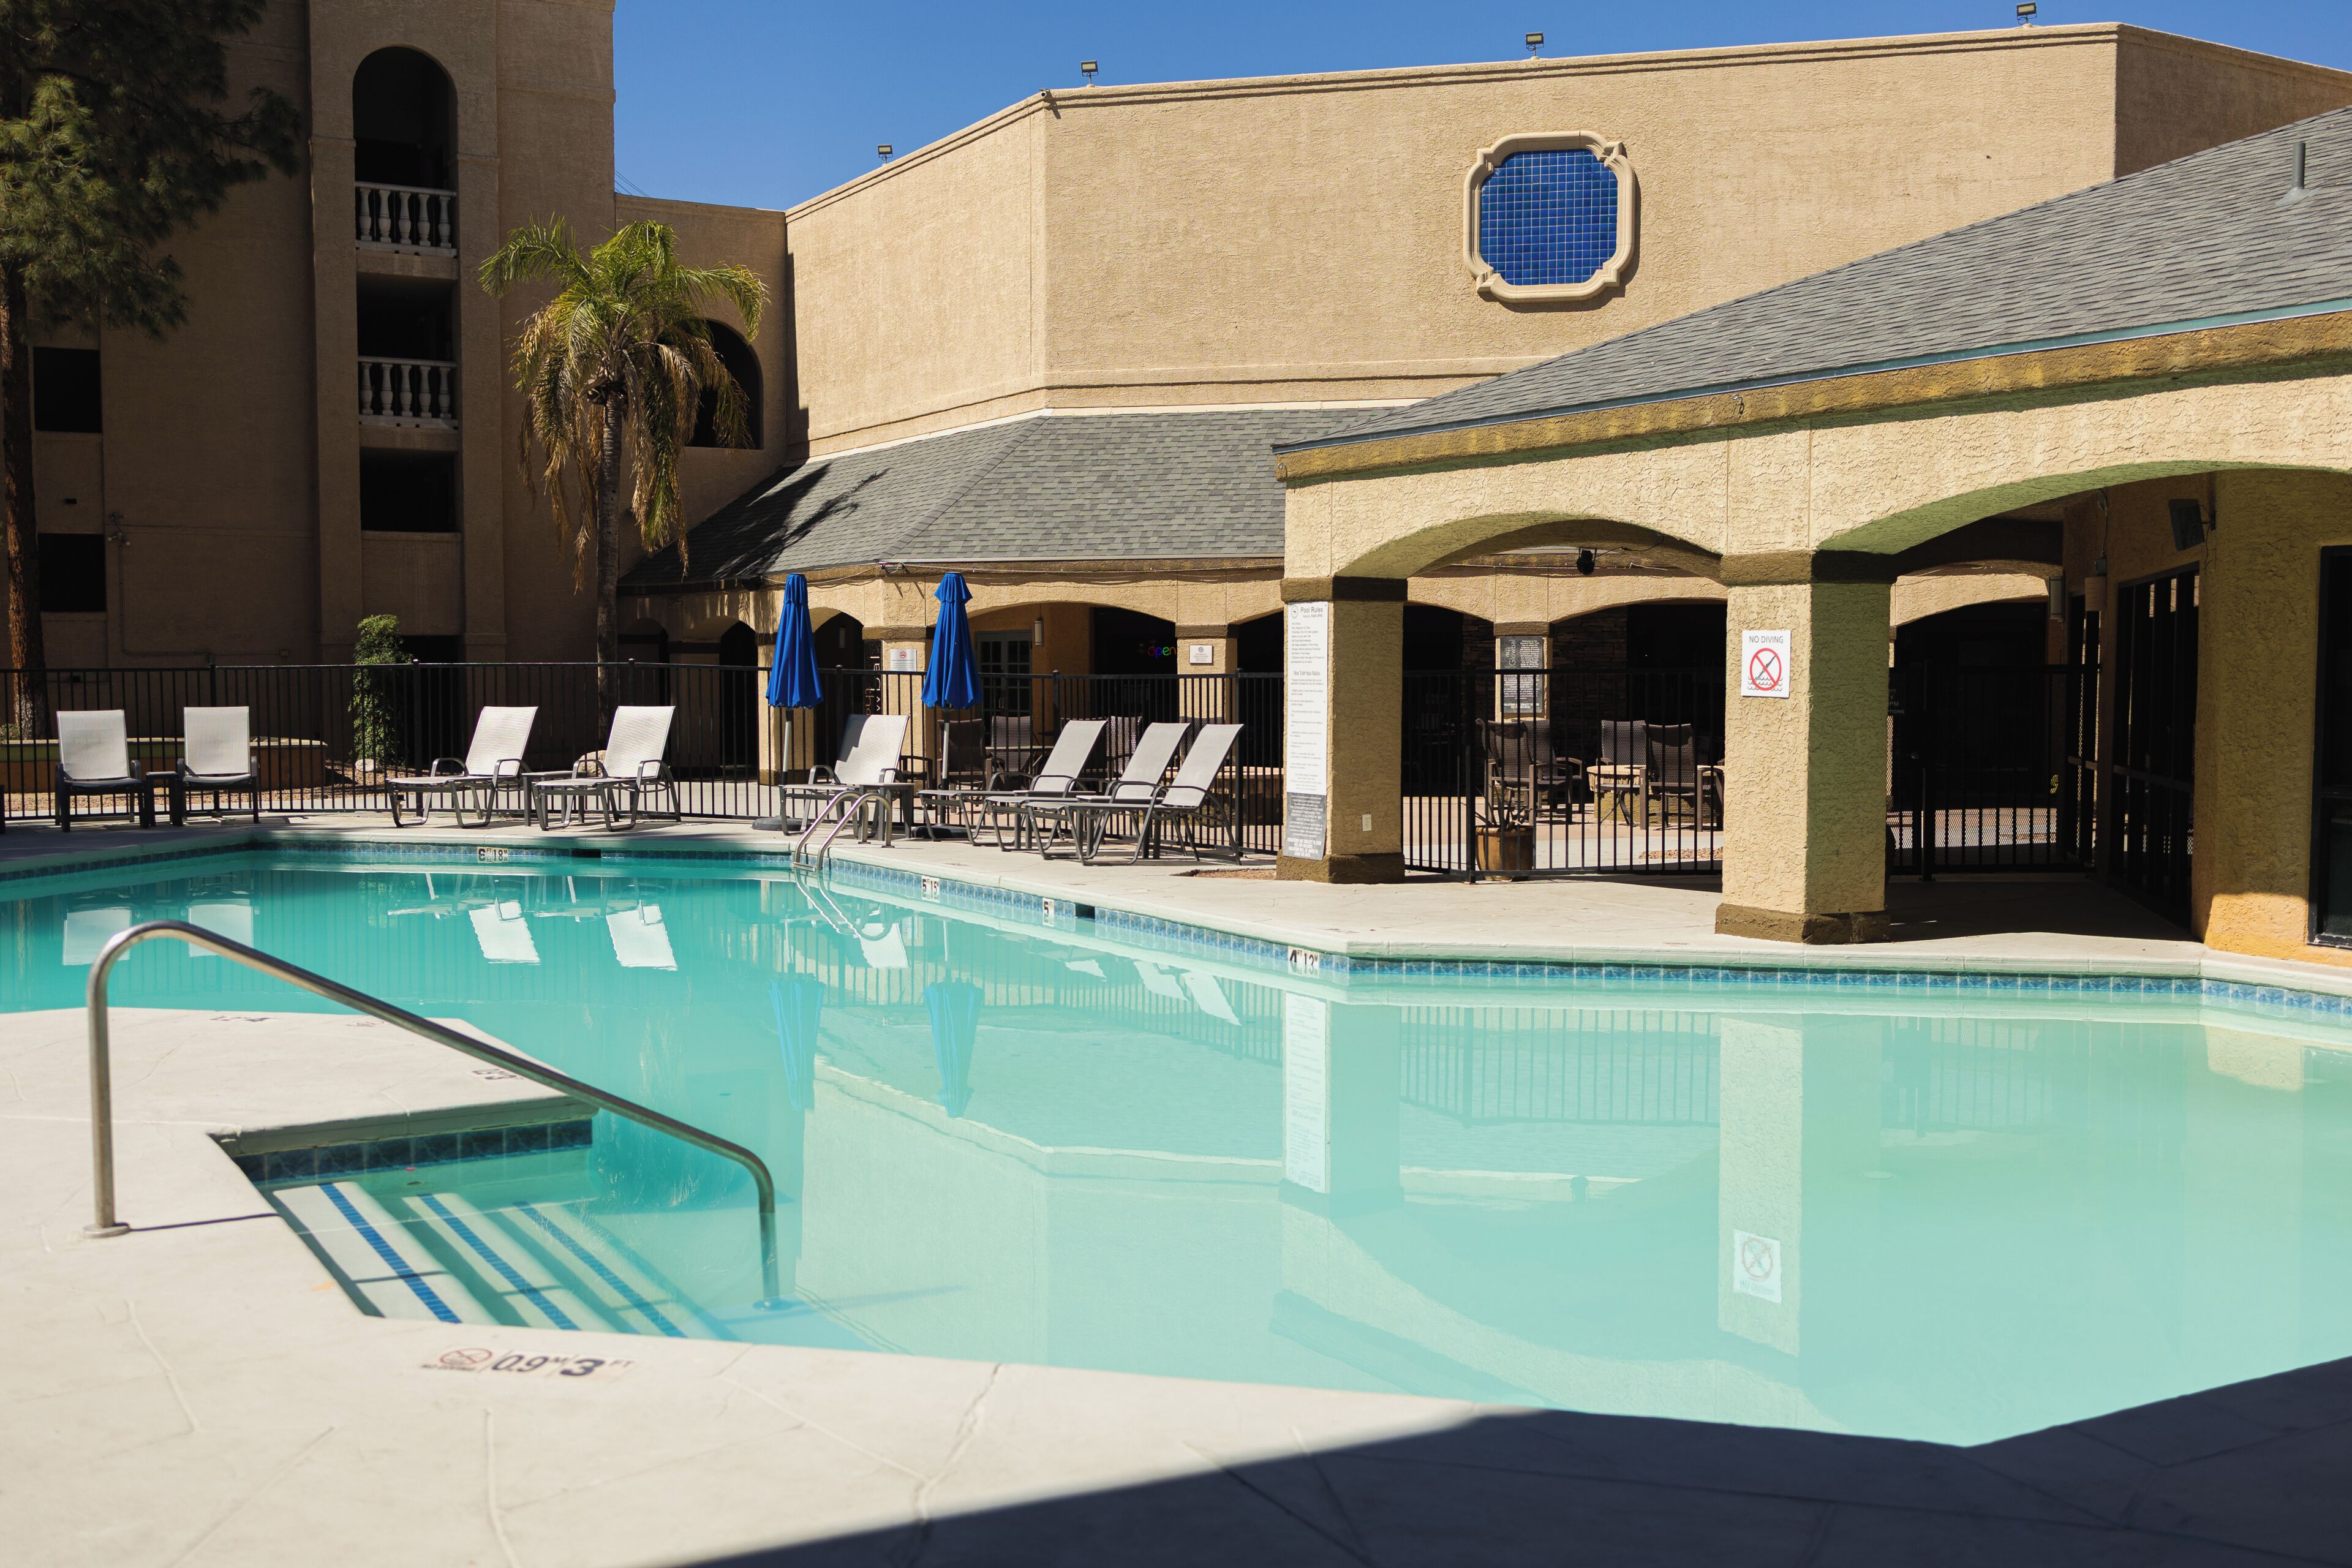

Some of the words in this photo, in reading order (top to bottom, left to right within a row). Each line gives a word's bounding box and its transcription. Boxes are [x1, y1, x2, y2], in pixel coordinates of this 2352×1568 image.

[1044, 901, 1049, 914] 5
[491, 1354, 550, 1373] 0.9
[560, 1358, 606, 1377] 3
